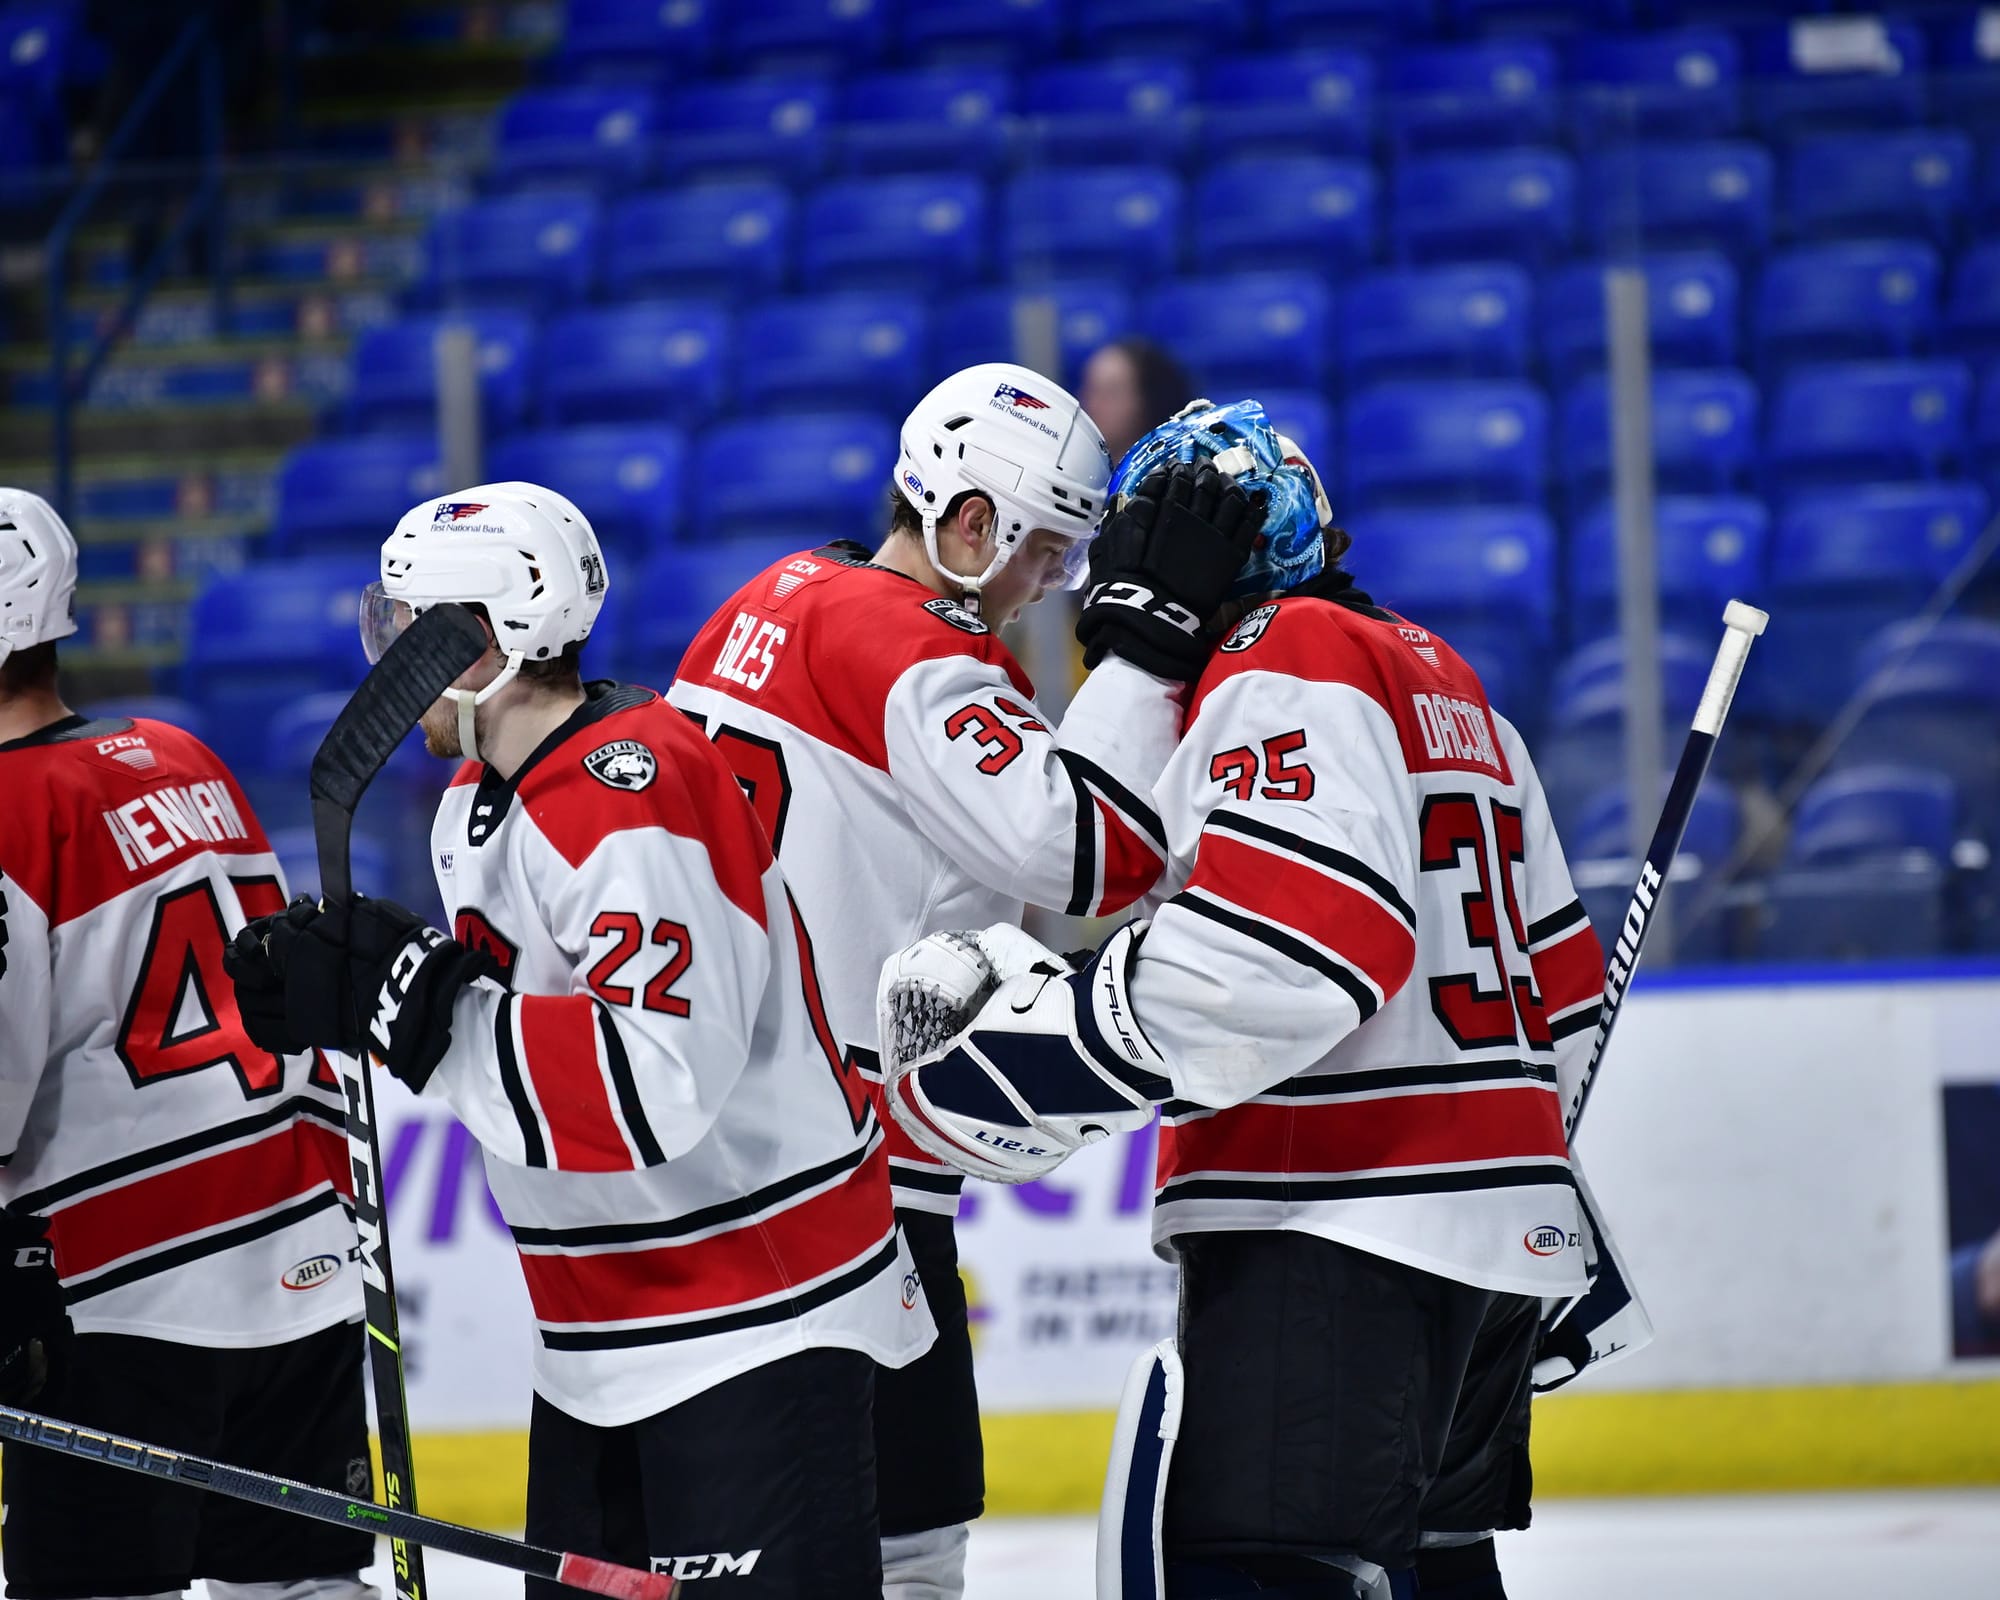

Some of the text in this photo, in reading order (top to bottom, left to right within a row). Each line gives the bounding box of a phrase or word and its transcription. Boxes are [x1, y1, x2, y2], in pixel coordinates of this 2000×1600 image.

[989, 398, 1060, 440] First National Bank
[430, 523, 505, 534] First National Bank
[786, 559, 823, 576] CCM
[1397, 627, 1430, 643] CCM
[712, 611, 787, 692] GILES
[96, 736, 147, 756] CCM
[1419, 792, 1556, 1051] 35
[586, 911, 693, 1019] 22
[369, 926, 450, 1051] CCM
[1102, 954, 1144, 1061] TRUE
[975, 1130, 1047, 1156] L12.2
[340, 1050, 387, 1294] CCM
[1533, 1231, 1560, 1248] AHL
[295, 1260, 332, 1286] AHL
[649, 1549, 762, 1581] CCM
